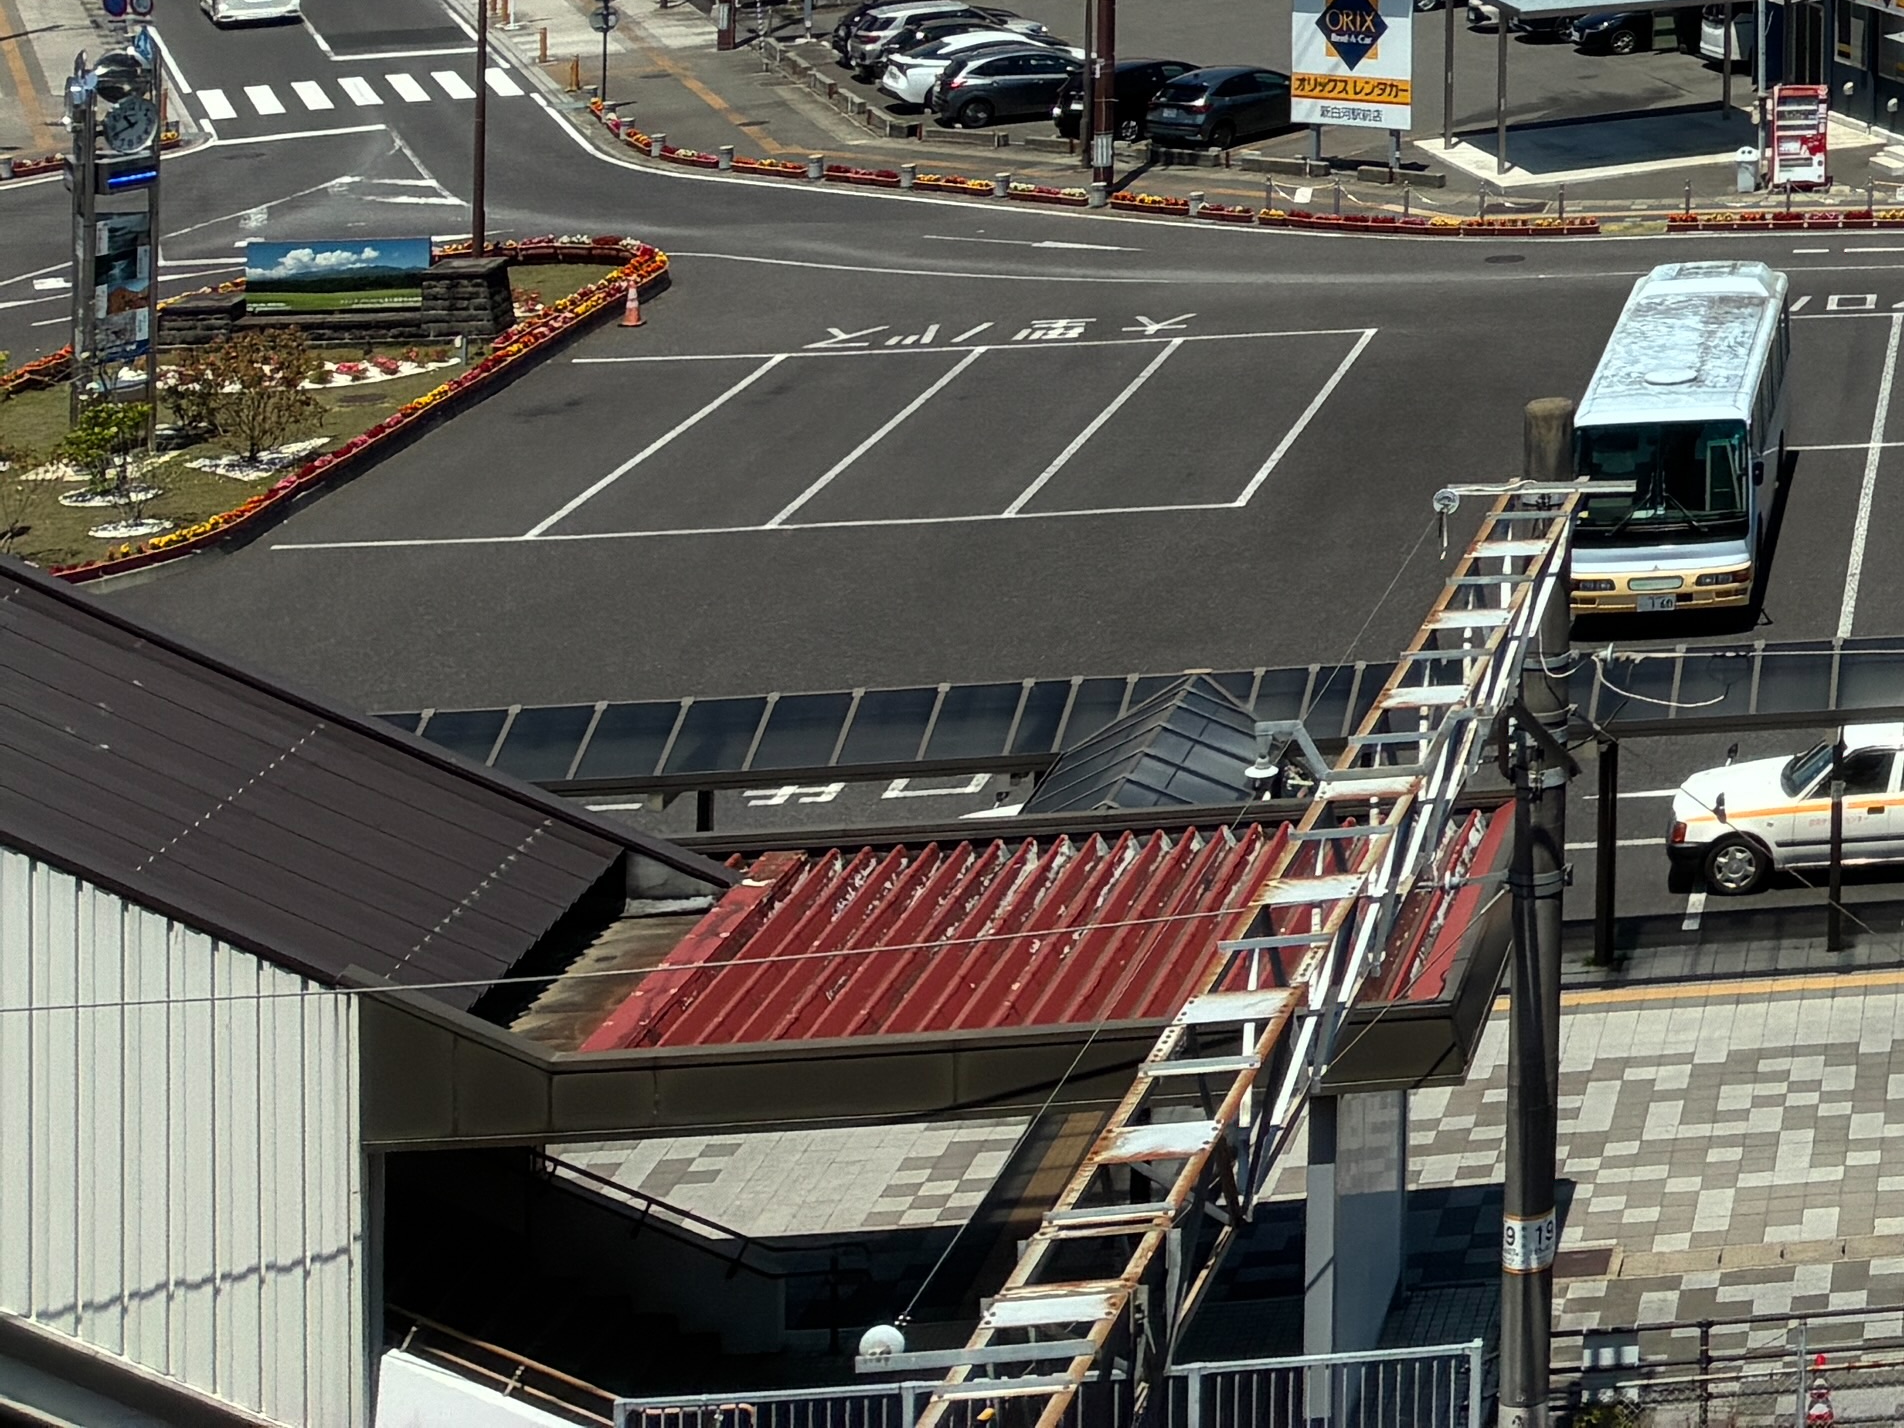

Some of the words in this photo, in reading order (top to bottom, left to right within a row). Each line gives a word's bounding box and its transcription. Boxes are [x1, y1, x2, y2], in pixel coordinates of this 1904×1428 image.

[1325, 8, 1376, 33] ORIX
[1294, 77, 1349, 95] オリックス
[1353, 79, 1409, 98] レンタカー
[1535, 1220, 1554, 1245] 19
